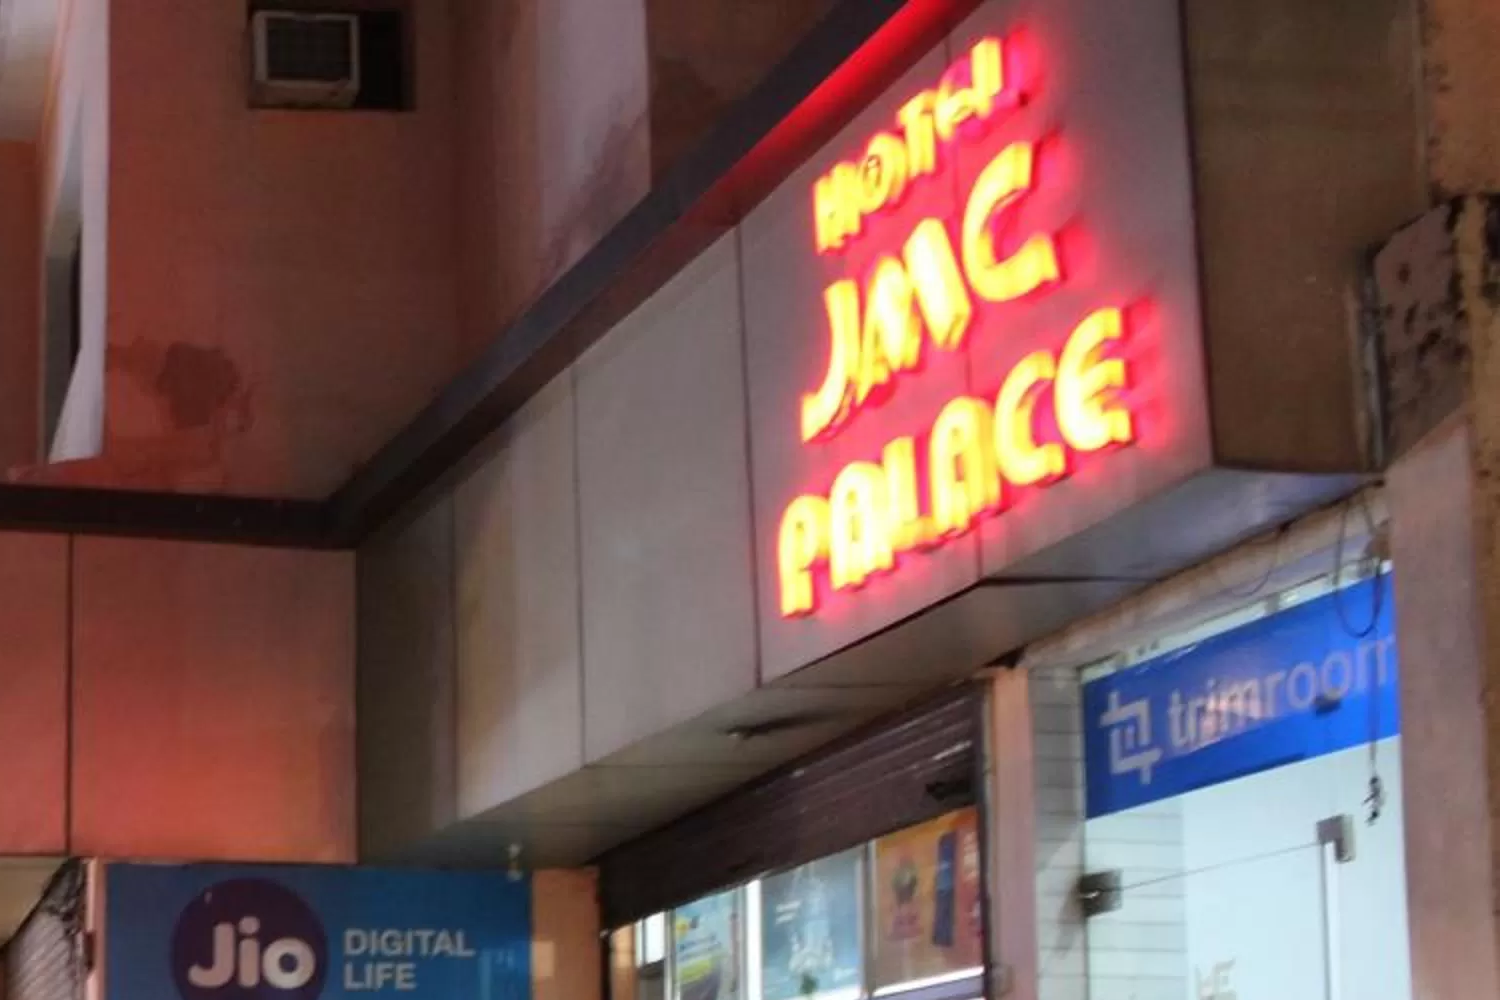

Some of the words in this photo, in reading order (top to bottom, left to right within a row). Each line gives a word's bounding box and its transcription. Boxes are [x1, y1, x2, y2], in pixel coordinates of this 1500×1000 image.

[813, 37, 1003, 255] HOTEL
[802, 141, 1059, 443] JMC
[778, 306, 1132, 618] PALACE
[187, 915, 317, 990] Jio
[343, 928, 476, 957] DIGITAL
[343, 962, 417, 990] LIFE
